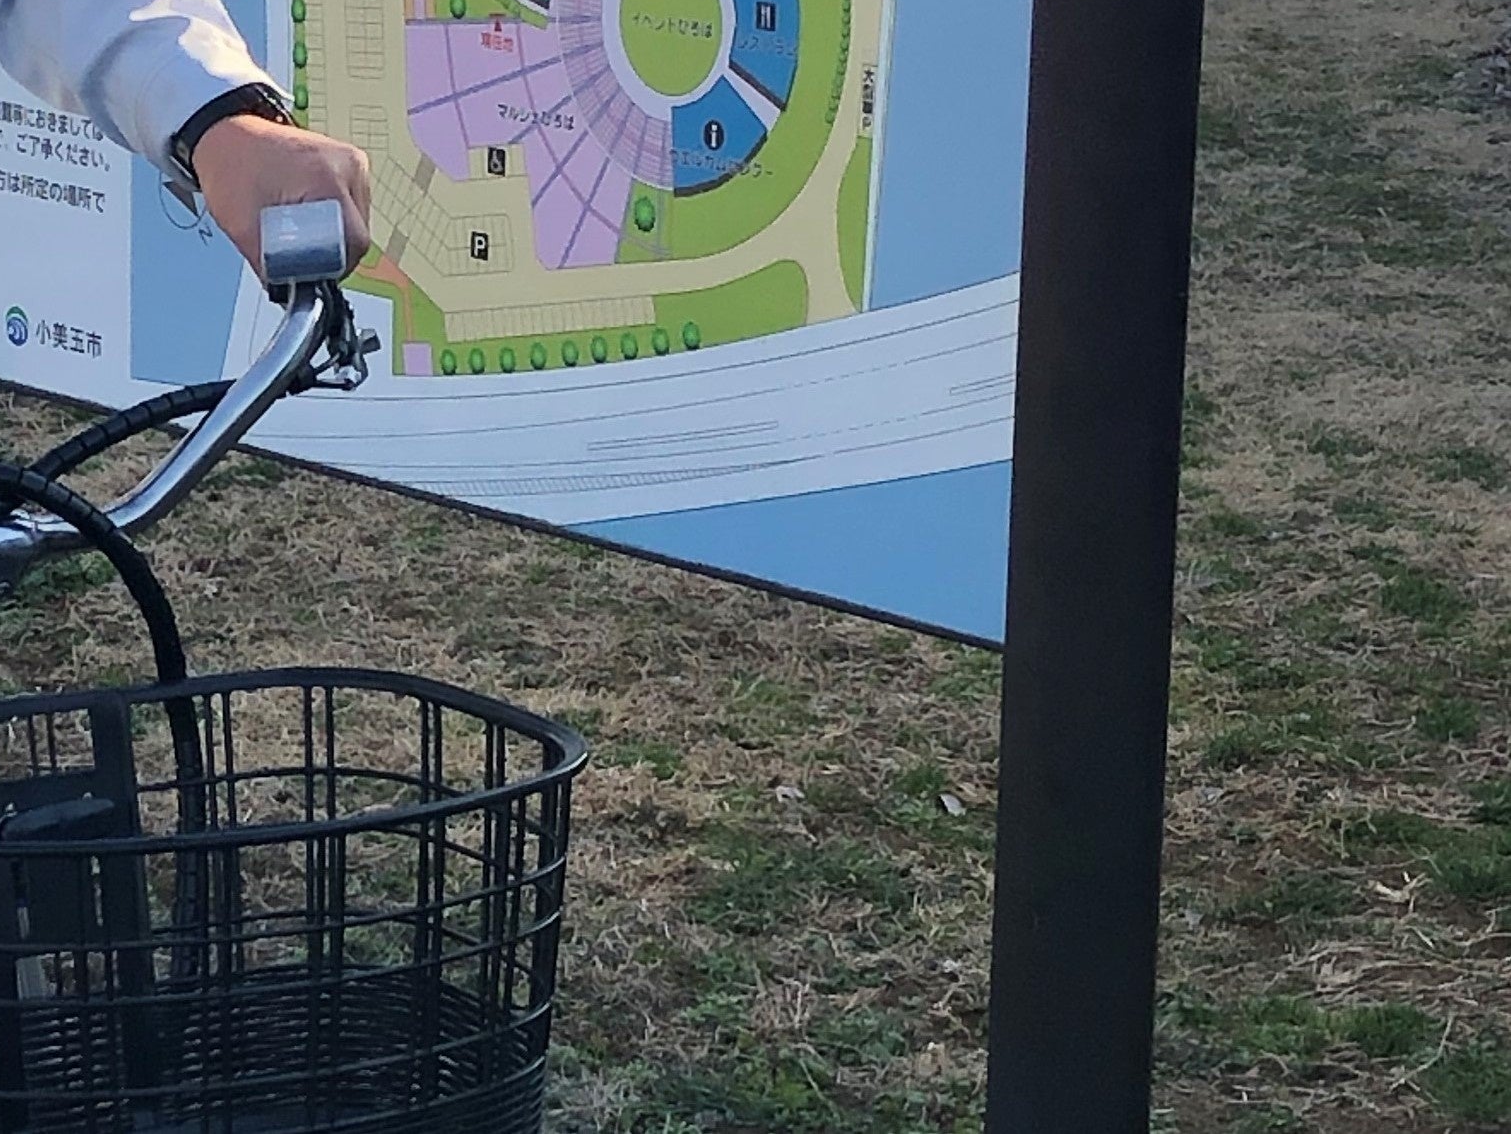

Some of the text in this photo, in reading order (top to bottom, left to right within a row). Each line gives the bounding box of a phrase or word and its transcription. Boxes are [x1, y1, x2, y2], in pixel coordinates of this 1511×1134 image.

[474, 236, 486, 257] P
[35, 318, 102, 359] 小美玉市
